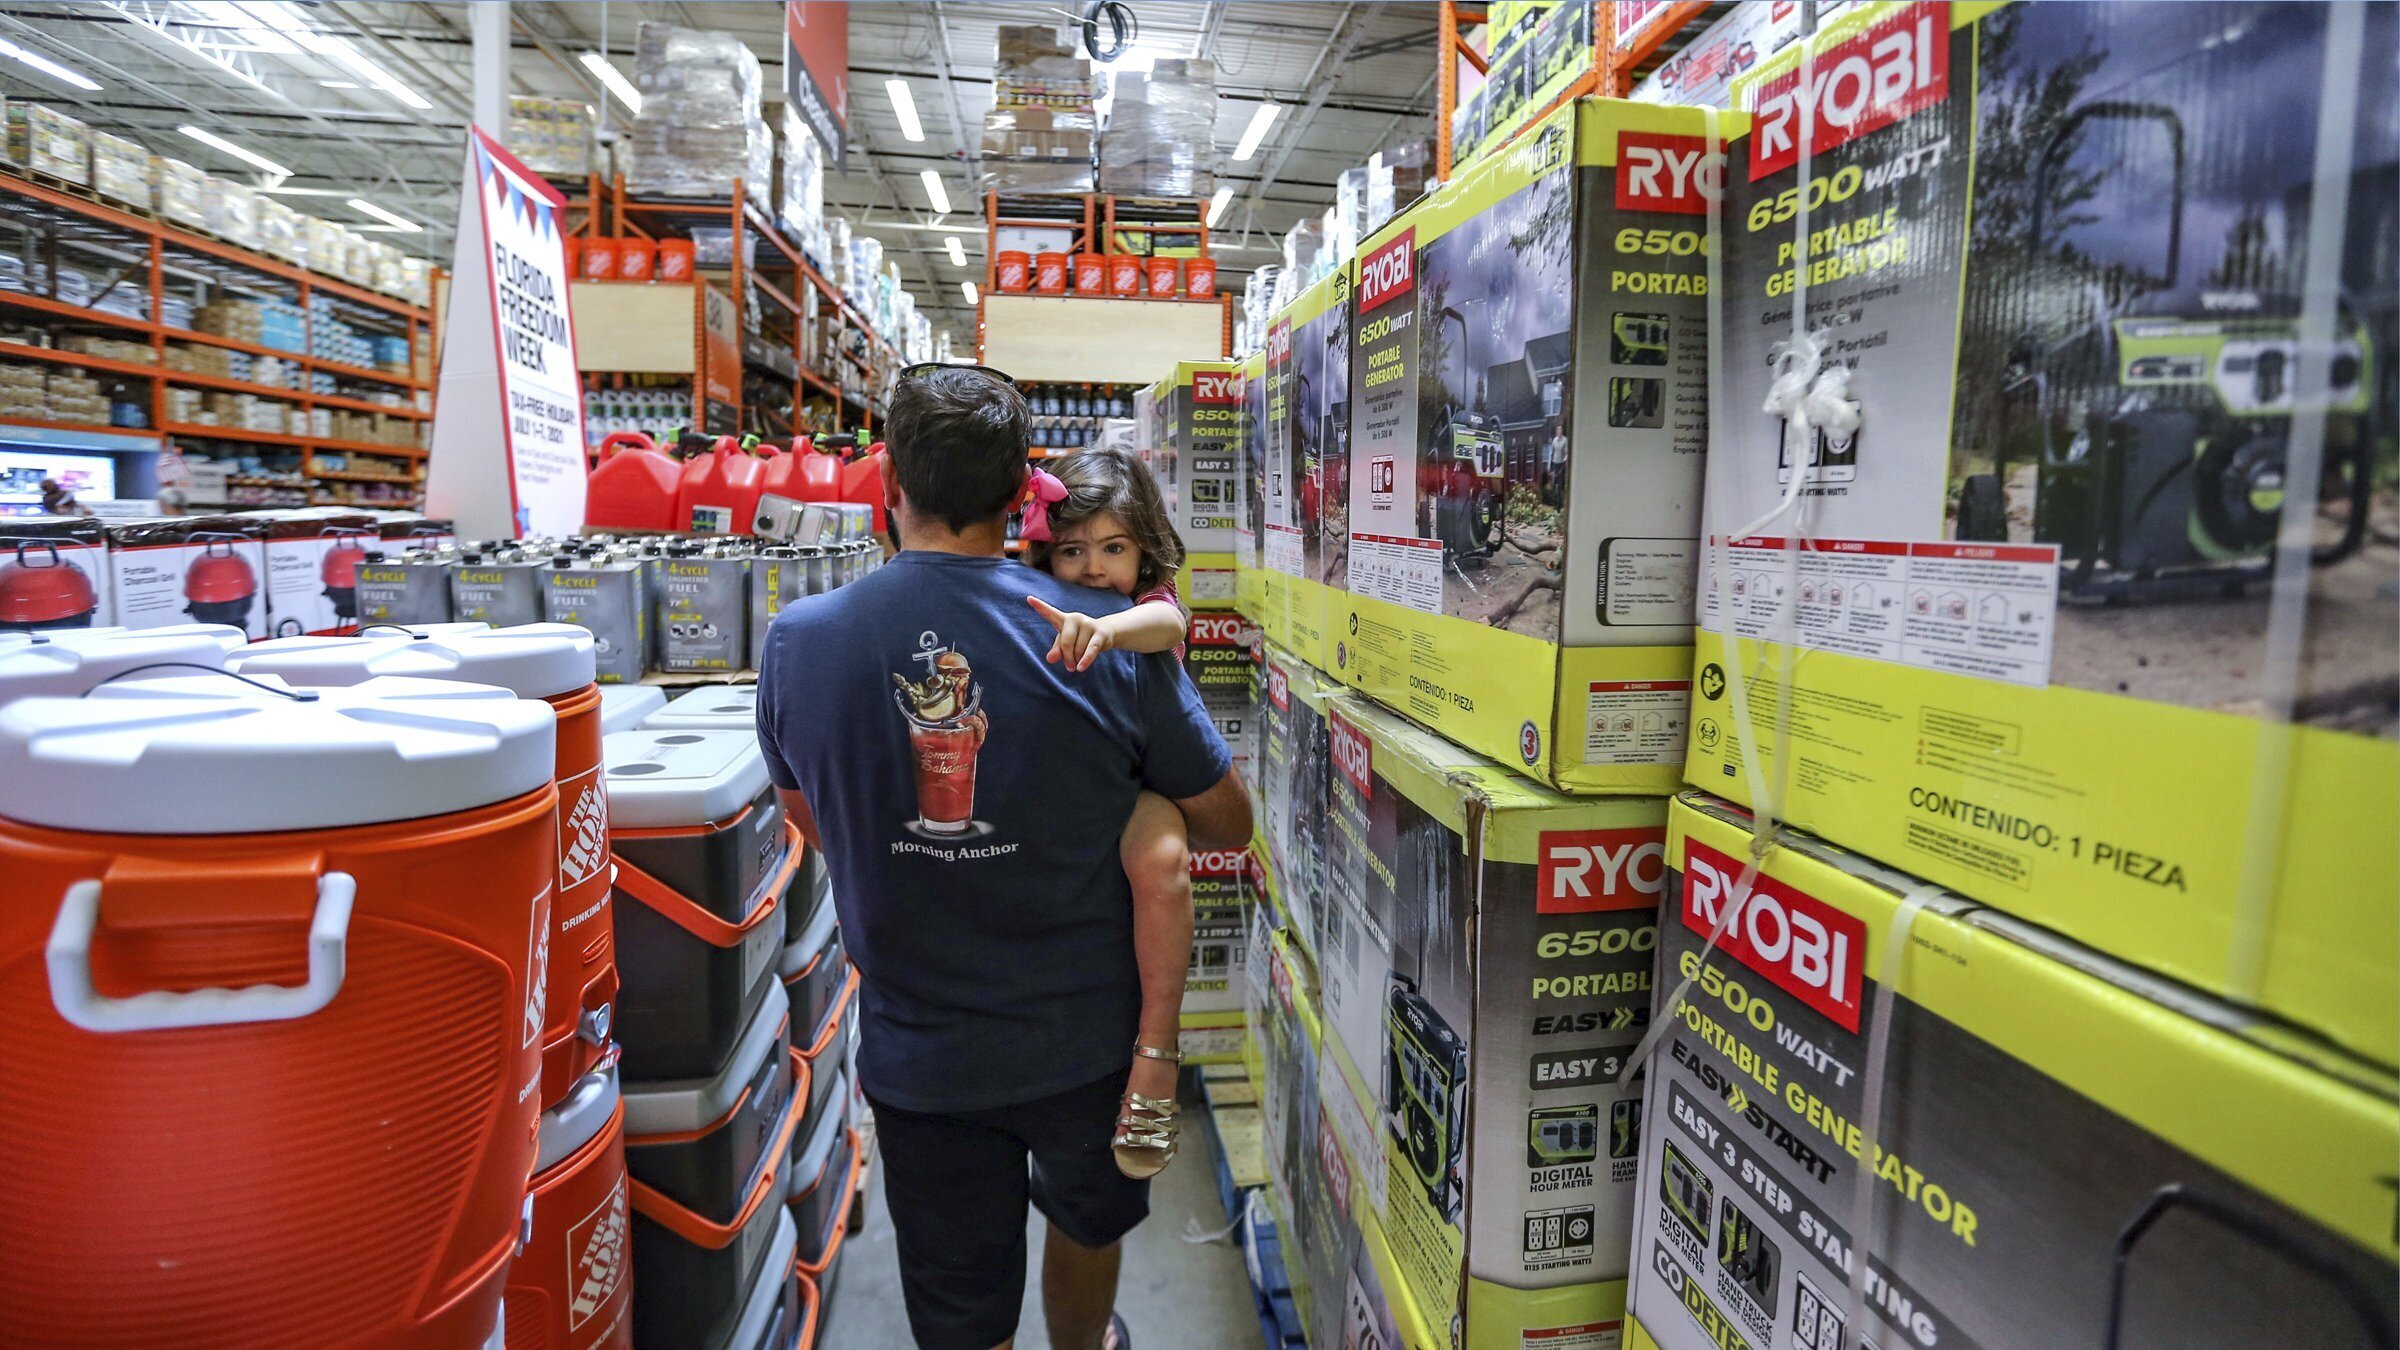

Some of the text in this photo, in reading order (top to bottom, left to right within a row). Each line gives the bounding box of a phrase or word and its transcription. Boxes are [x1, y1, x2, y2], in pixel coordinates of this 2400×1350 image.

[1760, 16, 1932, 160] RYOBI
[1747, 137, 1950, 232] 6500 WATT
[495, 240, 556, 308] FLORIDA
[1363, 240, 1411, 303] RYOBI
[500, 284, 567, 348] FREEDOM
[1360, 311, 1413, 346] 6500 WATT
[1848, 308, 1864, 323] W
[503, 324, 547, 375] WEEK
[1368, 345, 1400, 370] PORTABLE
[1845, 356, 1859, 370] W
[1365, 363, 1404, 388] GENERATOR
[514, 416, 529, 435] JULY
[1196, 461, 1220, 470] EASY
[1827, 487, 1848, 496] WATTS
[1842, 541, 1865, 551] DANGER
[123, 566, 156, 576] Portable
[361, 568, 407, 582] 4-CYCLE
[459, 570, 503, 582] 4-CYCLE
[553, 575, 597, 588] 4-CYCLE
[669, 562, 709, 576] 4-CYCLE
[361, 591, 398, 600] FUEL
[460, 592, 494, 601] FUEL
[553, 597, 588, 606] FUEL
[669, 584, 700, 593] FUEL
[1190, 651, 1238, 662] 6500
[1409, 675, 1447, 701] CONTENIDO:
[1449, 692, 1452, 703] 1
[1454, 693, 1475, 714] PIEZA
[921, 744, 962, 764] Tommy
[1332, 720, 1370, 786] RYOBI
[1524, 728, 1536, 757] 3
[921, 760, 970, 775] Bahama
[567, 785, 592, 831] THE
[1332, 776, 1372, 833] 6500 WATT
[891, 841, 1020, 862] Morning Anchor
[1909, 787, 2060, 851] CONTENIDO:
[2070, 836, 2082, 859] 1
[2092, 842, 2189, 895] PIEZA
[1358, 837, 1396, 895] GENERATOR
[562, 903, 601, 932] DRINKING
[1332, 865, 1344, 890] EASY
[1361, 905, 1390, 954] STARTING
[1536, 926, 1658, 959] 6500
[1691, 856, 1848, 1003] RYOBI
[1532, 971, 1651, 1000] PORTABL
[1406, 1007, 1424, 1033] RYOBI
[1532, 1009, 1614, 1036] EASY
[1680, 950, 1855, 1088] 6500 WATT
[1536, 1057, 1618, 1082] EASY 3
[1671, 1039, 1837, 1185] EASY START
[1675, 998, 1978, 1247] PORTABLE GENERATOR
[1674, 1095, 1720, 1151] EASY
[1723, 1140, 1737, 1168] 3
[1741, 1160, 1793, 1215] STEP
[1530, 1178, 1593, 1193] HOUR METER
[1531, 1166, 1593, 1184] DIGITAL
[579, 1217, 608, 1269] THE
[1659, 1220, 1705, 1277] HOUR METER
[1660, 1206, 1705, 1267] DIGITAL
[1541, 1259, 1571, 1271] STARTING
[1572, 1258, 1592, 1268] WATTS
[1656, 1250, 1751, 1350] CO DETE
[1717, 1288, 1727, 1302] FOR
[1727, 1299, 1740, 1316] EASY
[1717, 1280, 1772, 1344] FRAME DESIGN
[1718, 1269, 1773, 1335] HAND TRUCK
[1566, 1326, 1585, 1335] DANGER
